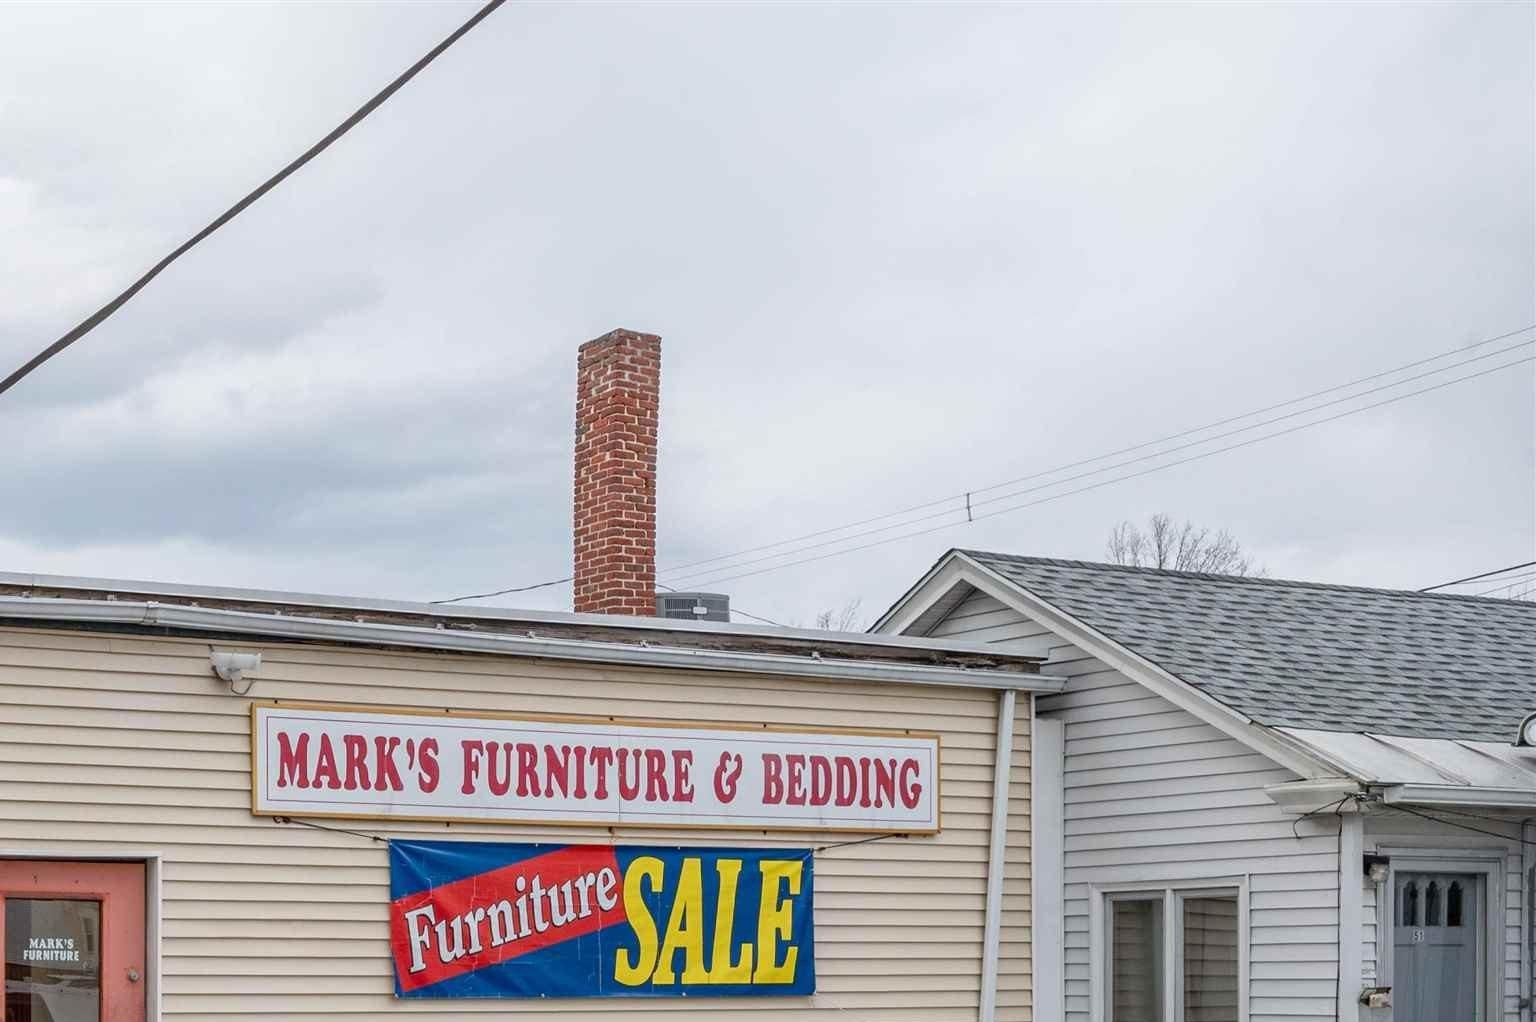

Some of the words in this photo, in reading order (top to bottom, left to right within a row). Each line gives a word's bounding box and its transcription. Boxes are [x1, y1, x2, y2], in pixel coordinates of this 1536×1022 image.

[276, 732, 440, 793] MARK'S
[461, 740, 695, 803] FURNITURE
[713, 751, 743, 804] &
[761, 753, 922, 809] BEDDING
[404, 866, 619, 975] Furniture
[613, 855, 804, 987] SALE
[24, 950, 79, 961] FURNITURE
[29, 938, 74, 949] MARK'S
